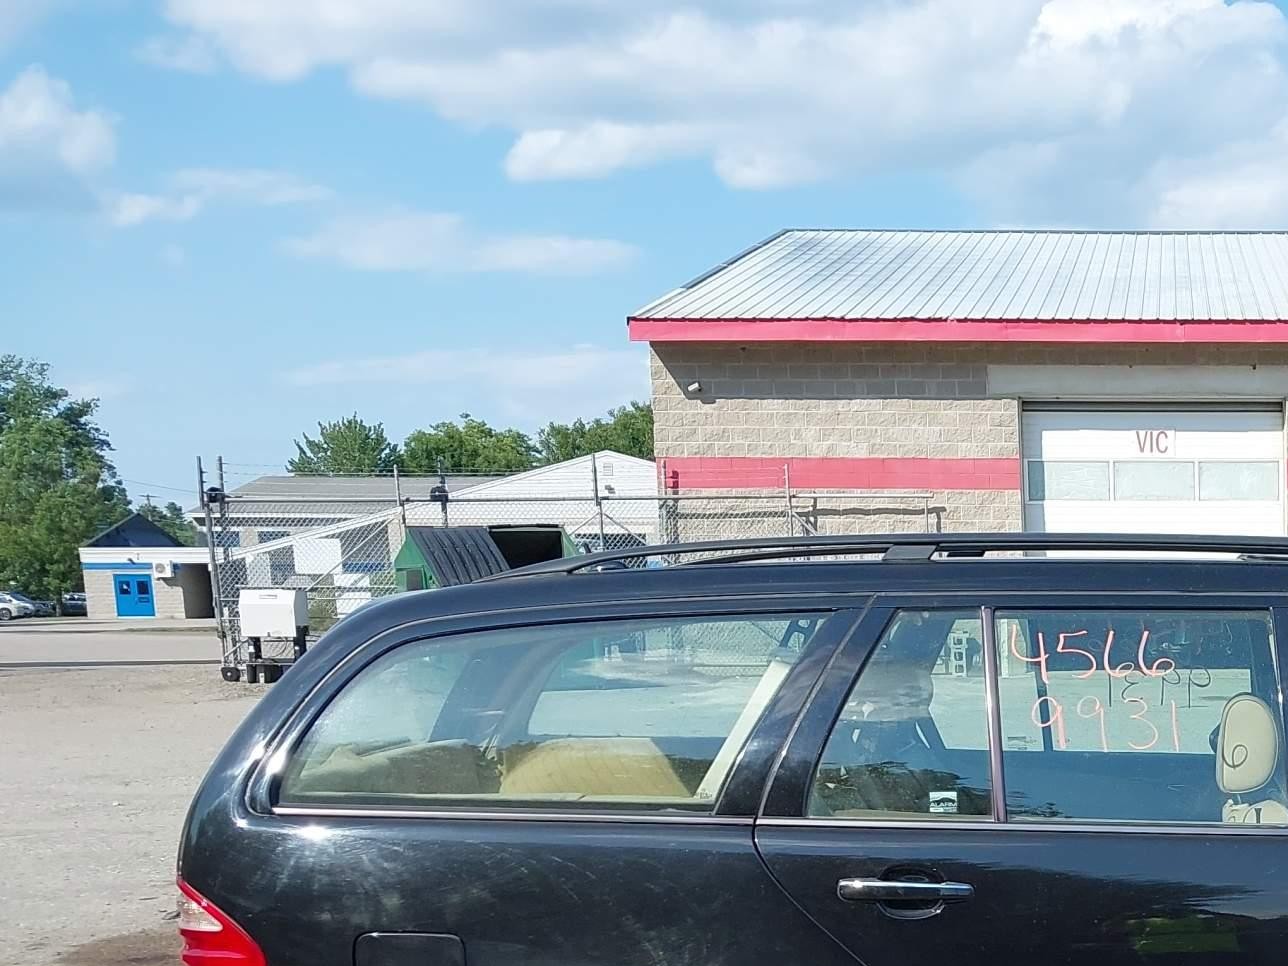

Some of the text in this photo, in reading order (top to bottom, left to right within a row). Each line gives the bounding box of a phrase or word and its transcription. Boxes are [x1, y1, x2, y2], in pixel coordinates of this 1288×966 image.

[1136, 430, 1169, 454] VIC
[1011, 624, 1175, 685] 4566
[1031, 695, 1180, 753] 9931
